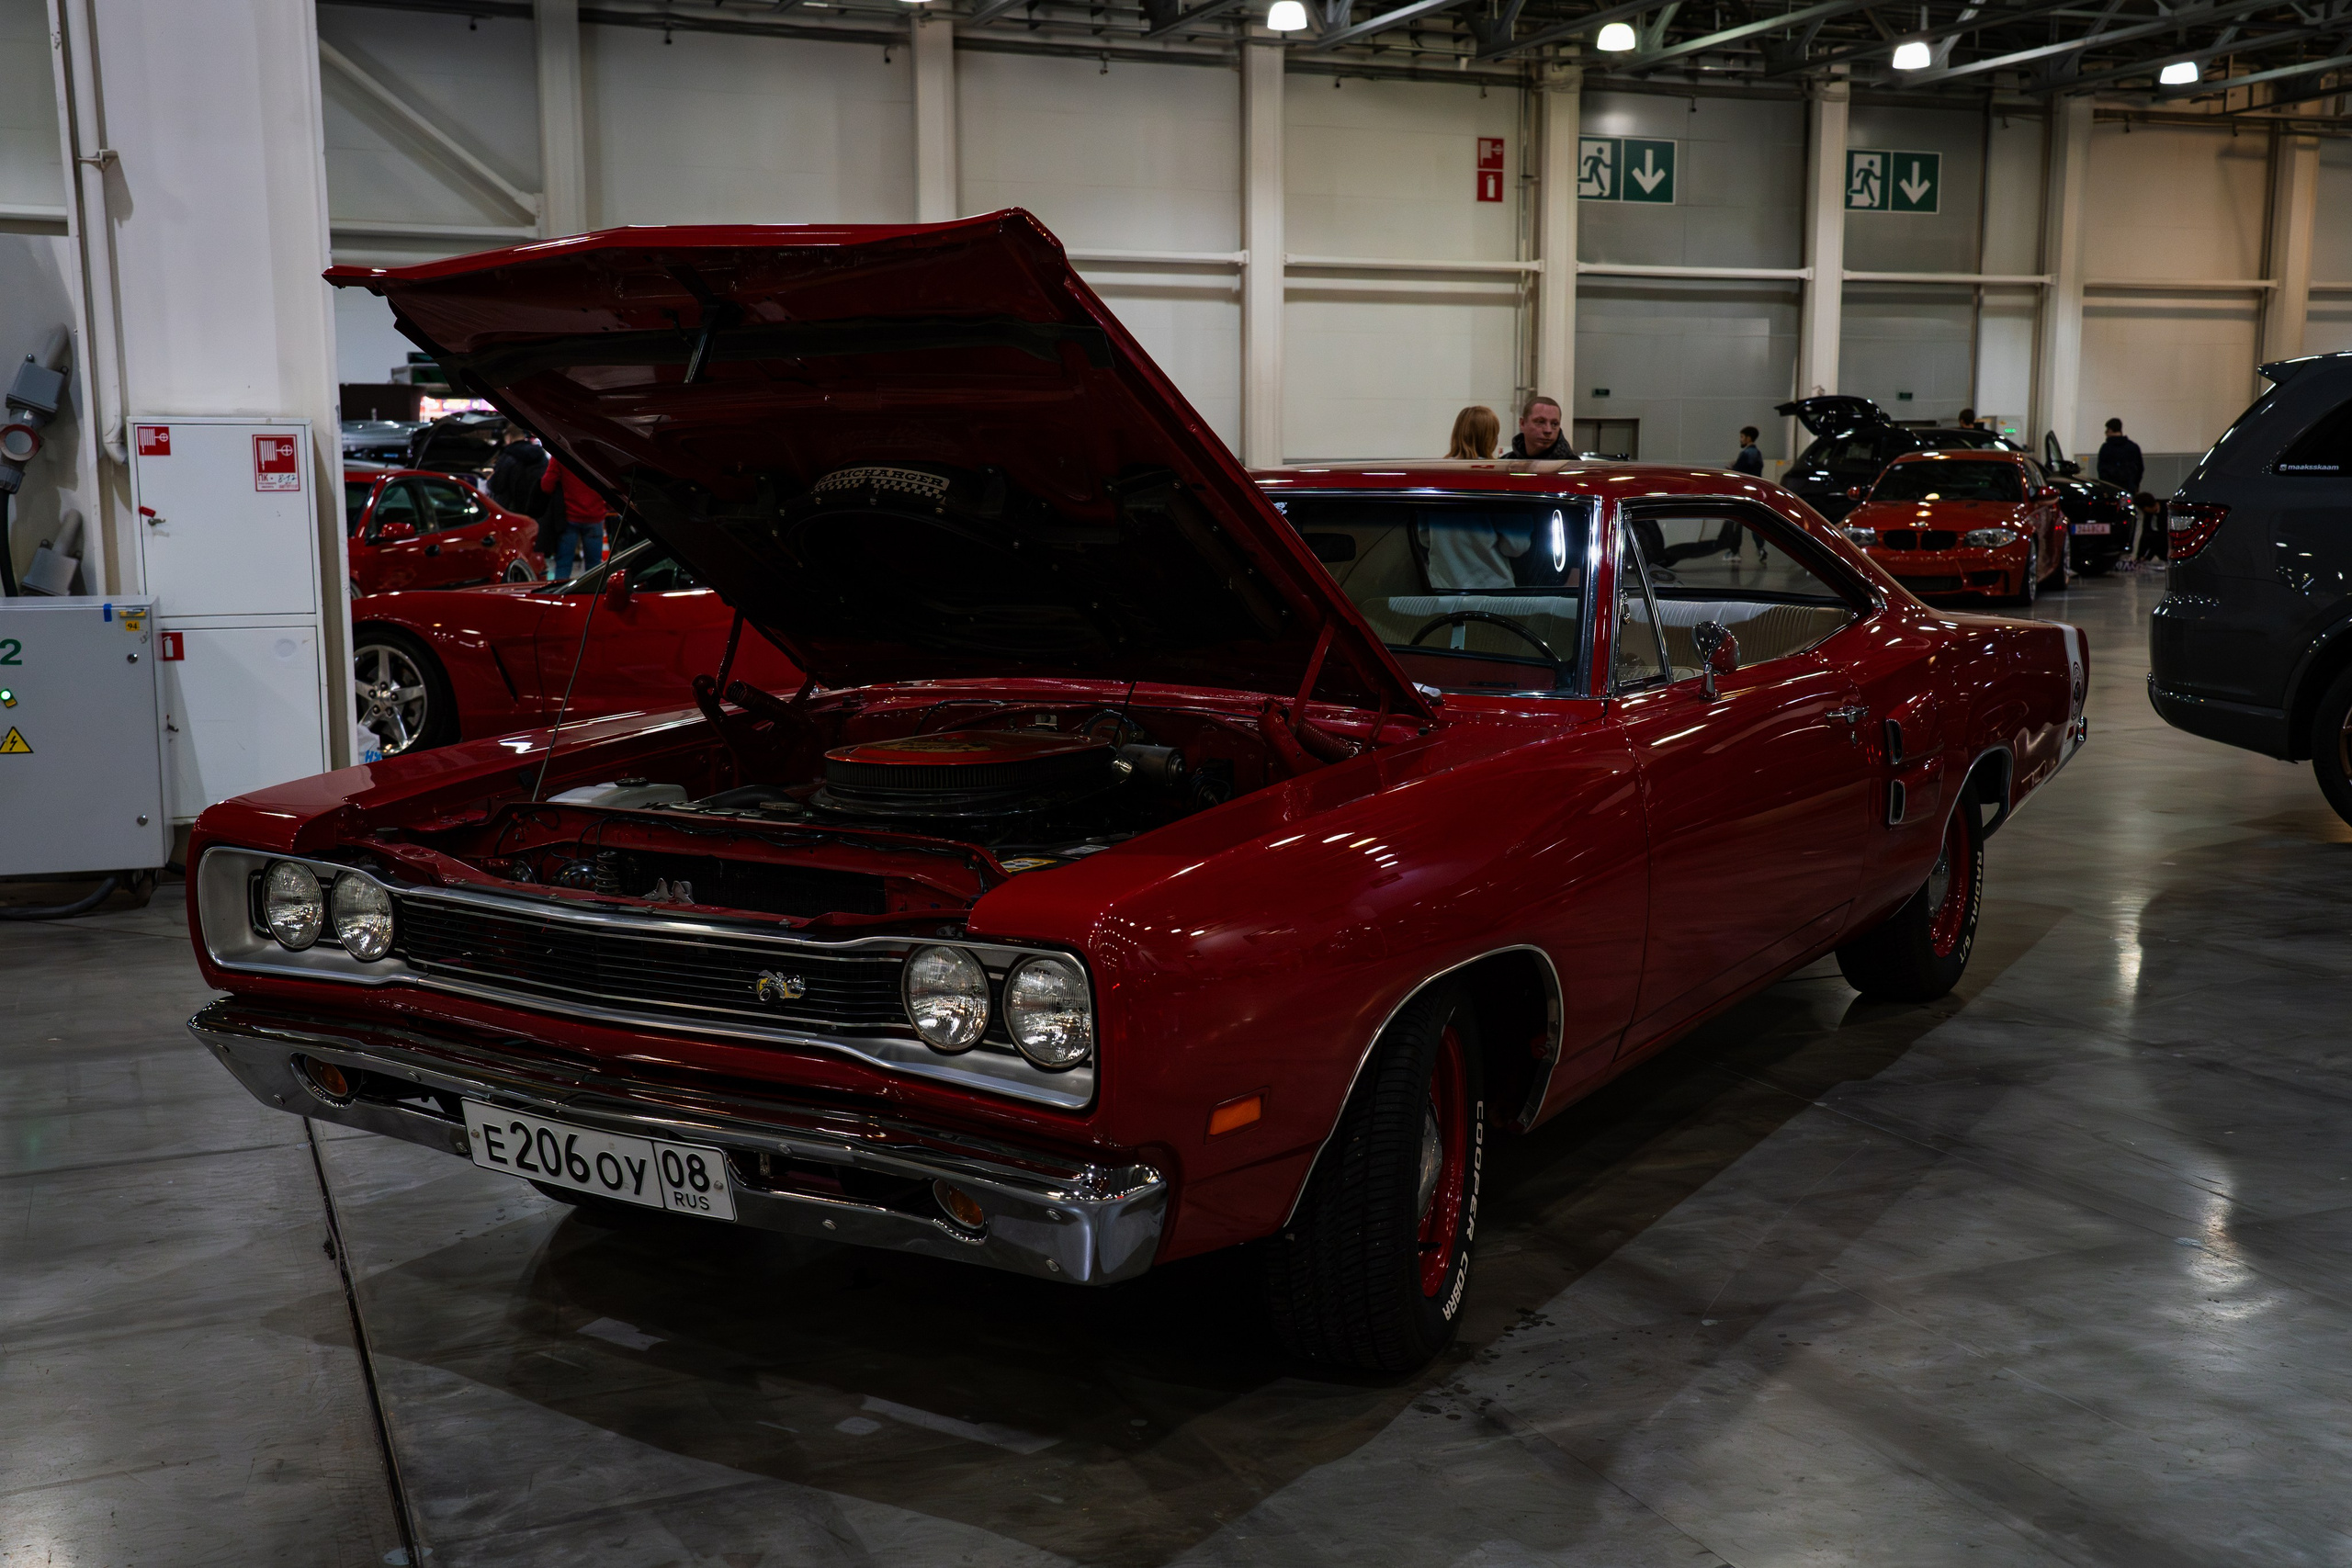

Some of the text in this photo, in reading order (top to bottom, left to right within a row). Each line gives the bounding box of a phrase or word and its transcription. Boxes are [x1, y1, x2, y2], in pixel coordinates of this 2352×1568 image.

[1969, 851, 1983, 927] RADIAL
[482, 1121, 710, 1195] E206OY 08
[673, 1191, 710, 1211] RUS
[1442, 1100, 1484, 1322] COOPER COBRA
